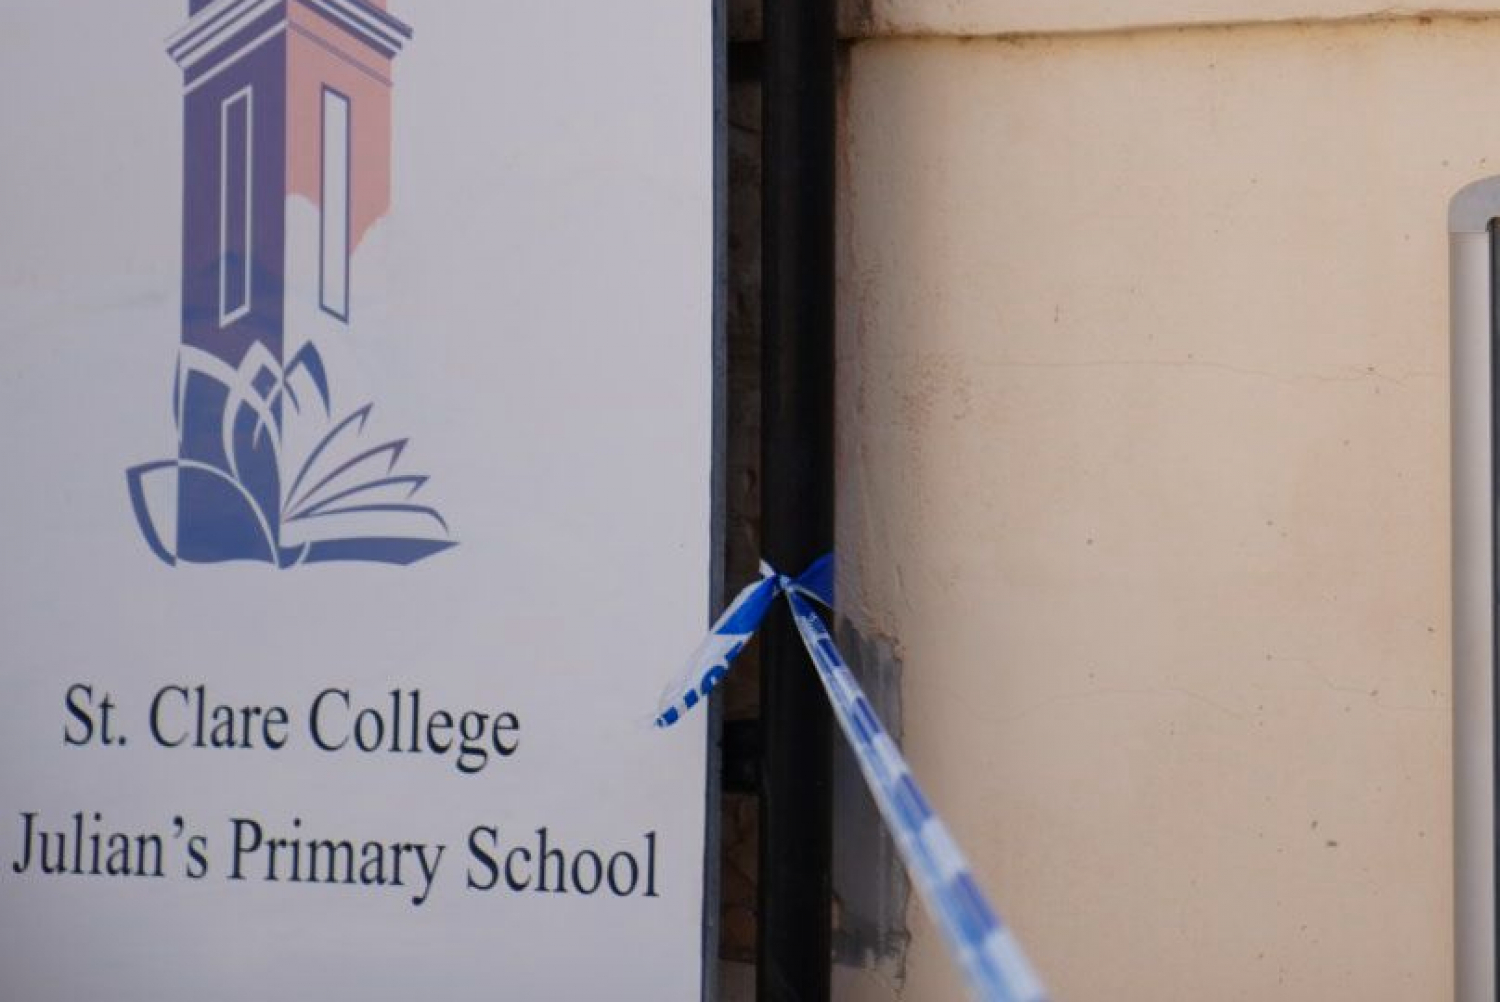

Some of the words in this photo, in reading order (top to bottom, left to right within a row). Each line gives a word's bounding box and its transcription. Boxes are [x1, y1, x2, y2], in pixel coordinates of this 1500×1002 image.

[64, 682, 127, 748] St.
[149, 684, 289, 751] Clare
[309, 687, 520, 775] College
[12, 810, 209, 879] Julian’s
[227, 816, 446, 907] Primary
[467, 825, 661, 898] School
